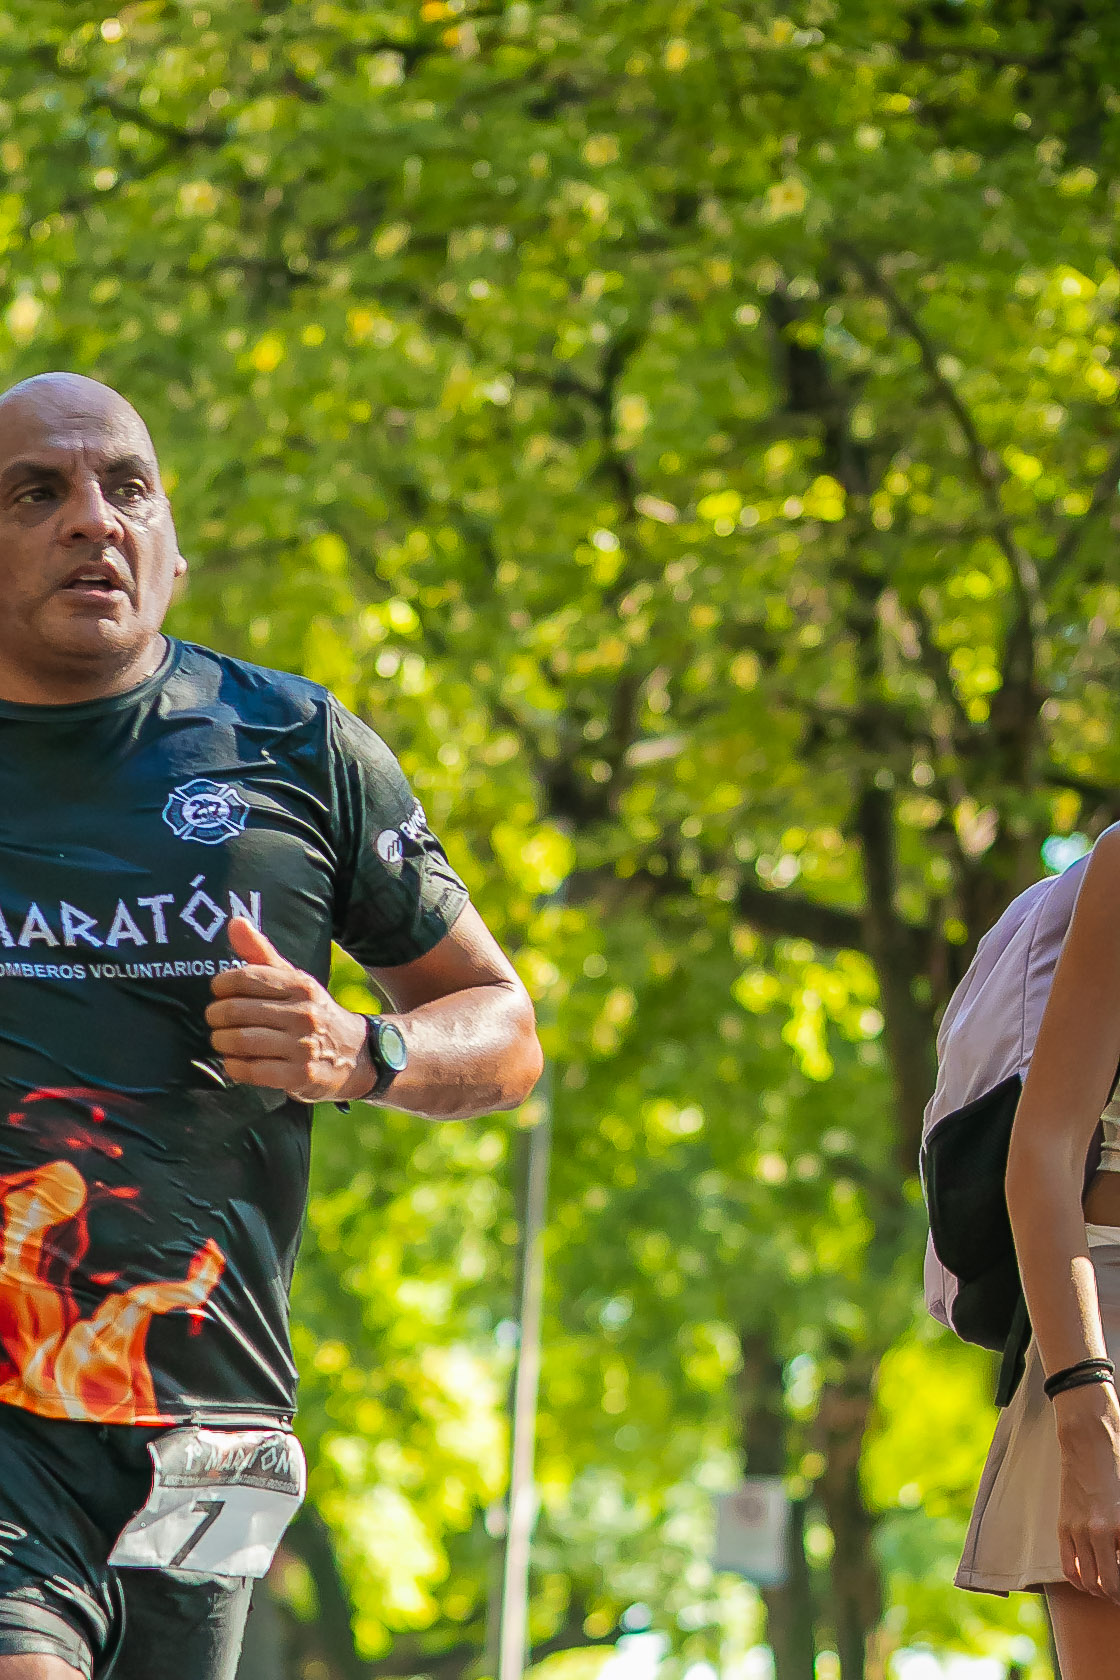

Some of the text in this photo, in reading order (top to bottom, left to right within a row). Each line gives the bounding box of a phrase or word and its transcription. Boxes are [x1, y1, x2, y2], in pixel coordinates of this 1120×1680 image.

[88, 960, 216, 979] VOLUNTARIOS
[204, 1435, 290, 1474] MARTÓN
[169, 1500, 226, 1567] 7
